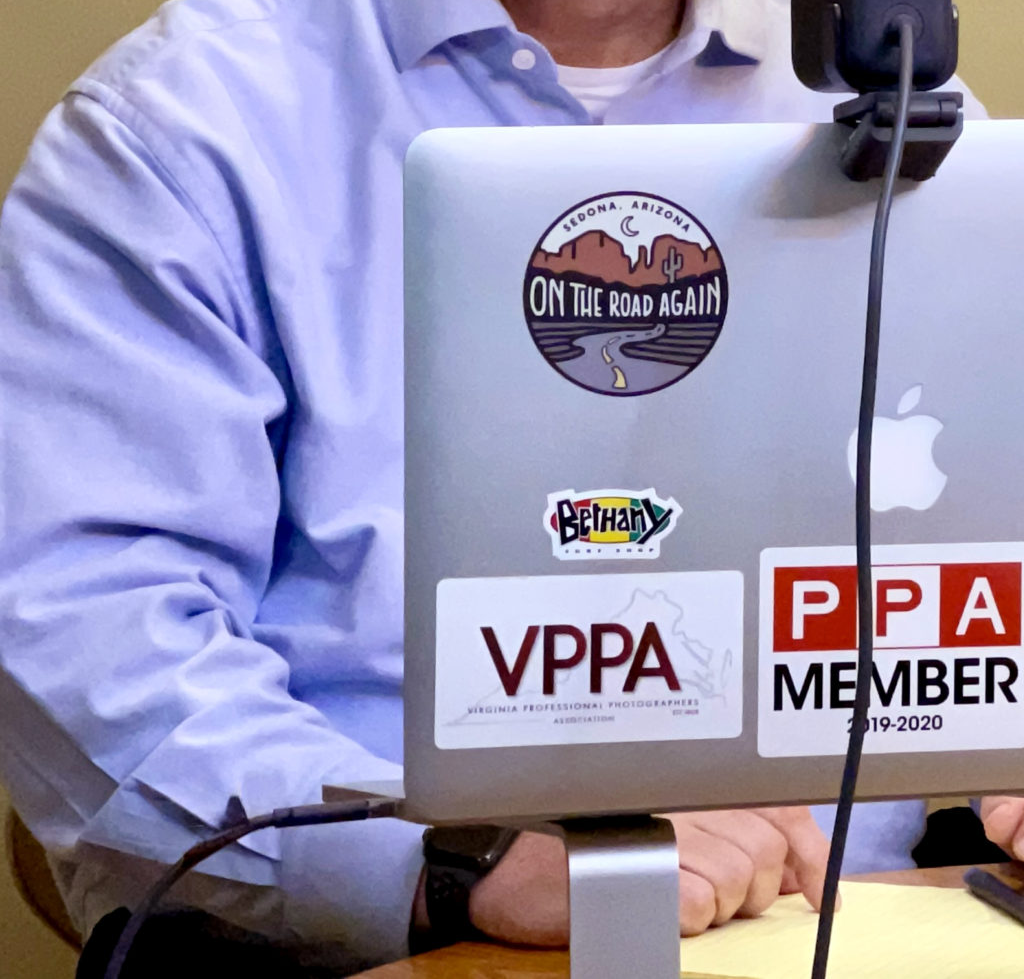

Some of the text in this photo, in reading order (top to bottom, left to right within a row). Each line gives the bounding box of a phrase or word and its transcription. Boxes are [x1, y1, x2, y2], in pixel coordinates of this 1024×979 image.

[631, 200, 690, 233] ARIZONA
[529, 275, 721, 318] ON THE ROAD AGAIN
[792, 576, 1006, 640] PPA
[480, 621, 682, 697] VPPA
[773, 656, 1019, 711] MEMBER
[467, 698, 699, 714] VIRGINIA PROFESSIONAL PHOTOGRAPHERS
